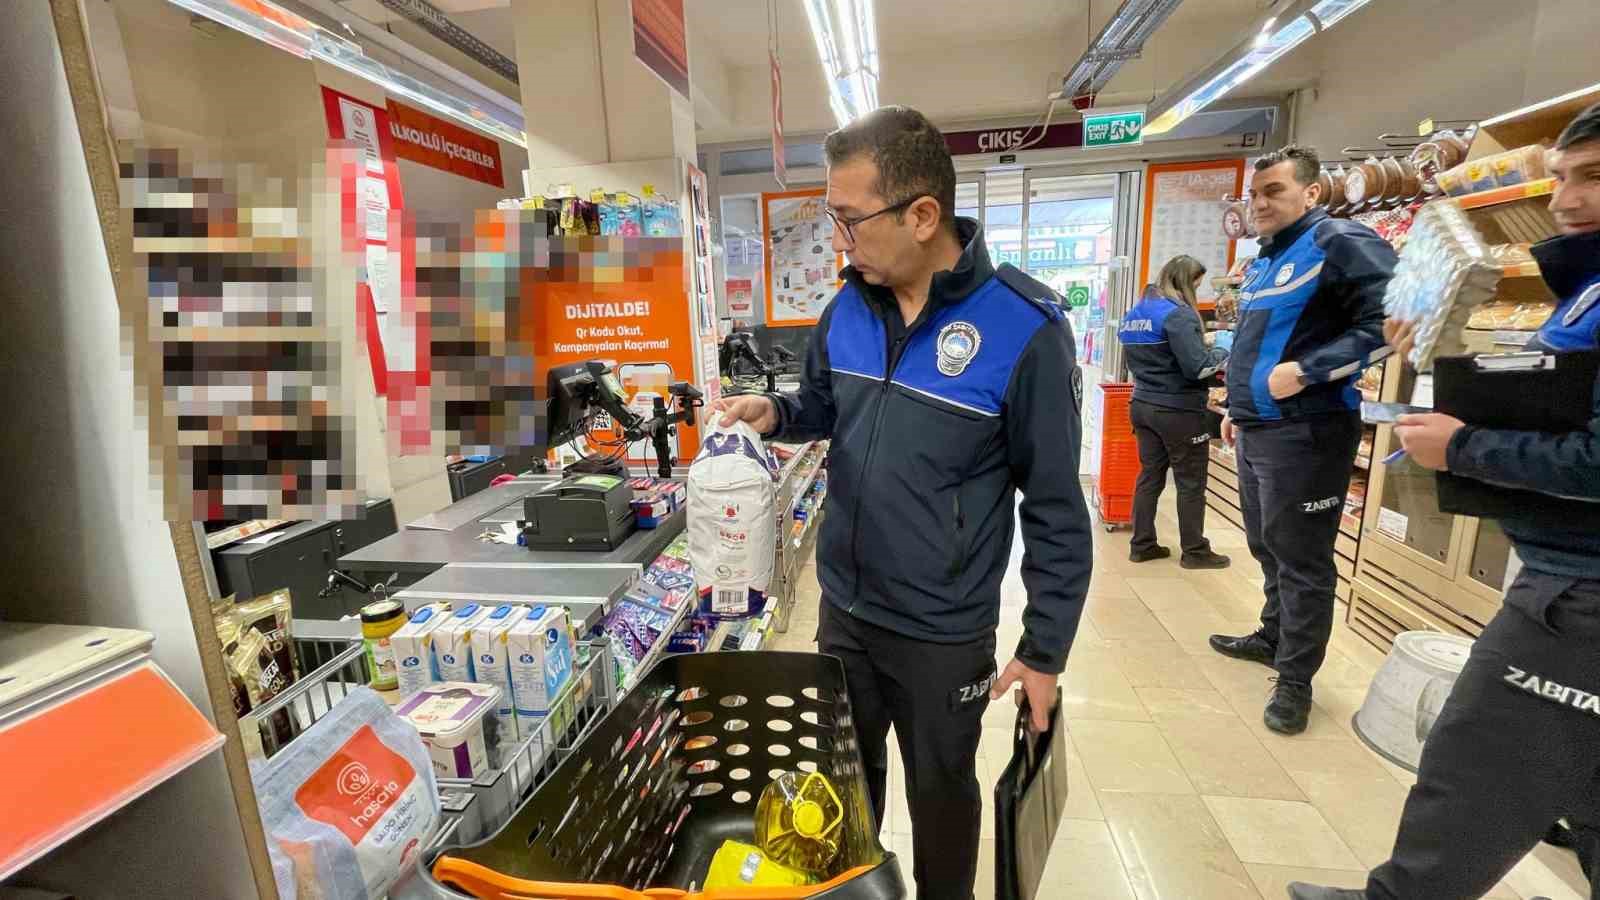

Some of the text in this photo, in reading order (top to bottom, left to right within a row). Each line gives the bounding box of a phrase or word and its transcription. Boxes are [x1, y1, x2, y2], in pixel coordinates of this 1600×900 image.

[1088, 132, 1108, 141] EXIT
[576, 325, 644, 339] Qr Kodu Okut,
[553, 338, 670, 354] Kampanyaları Kaçırma!
[1504, 665, 1600, 715] ZABITA
